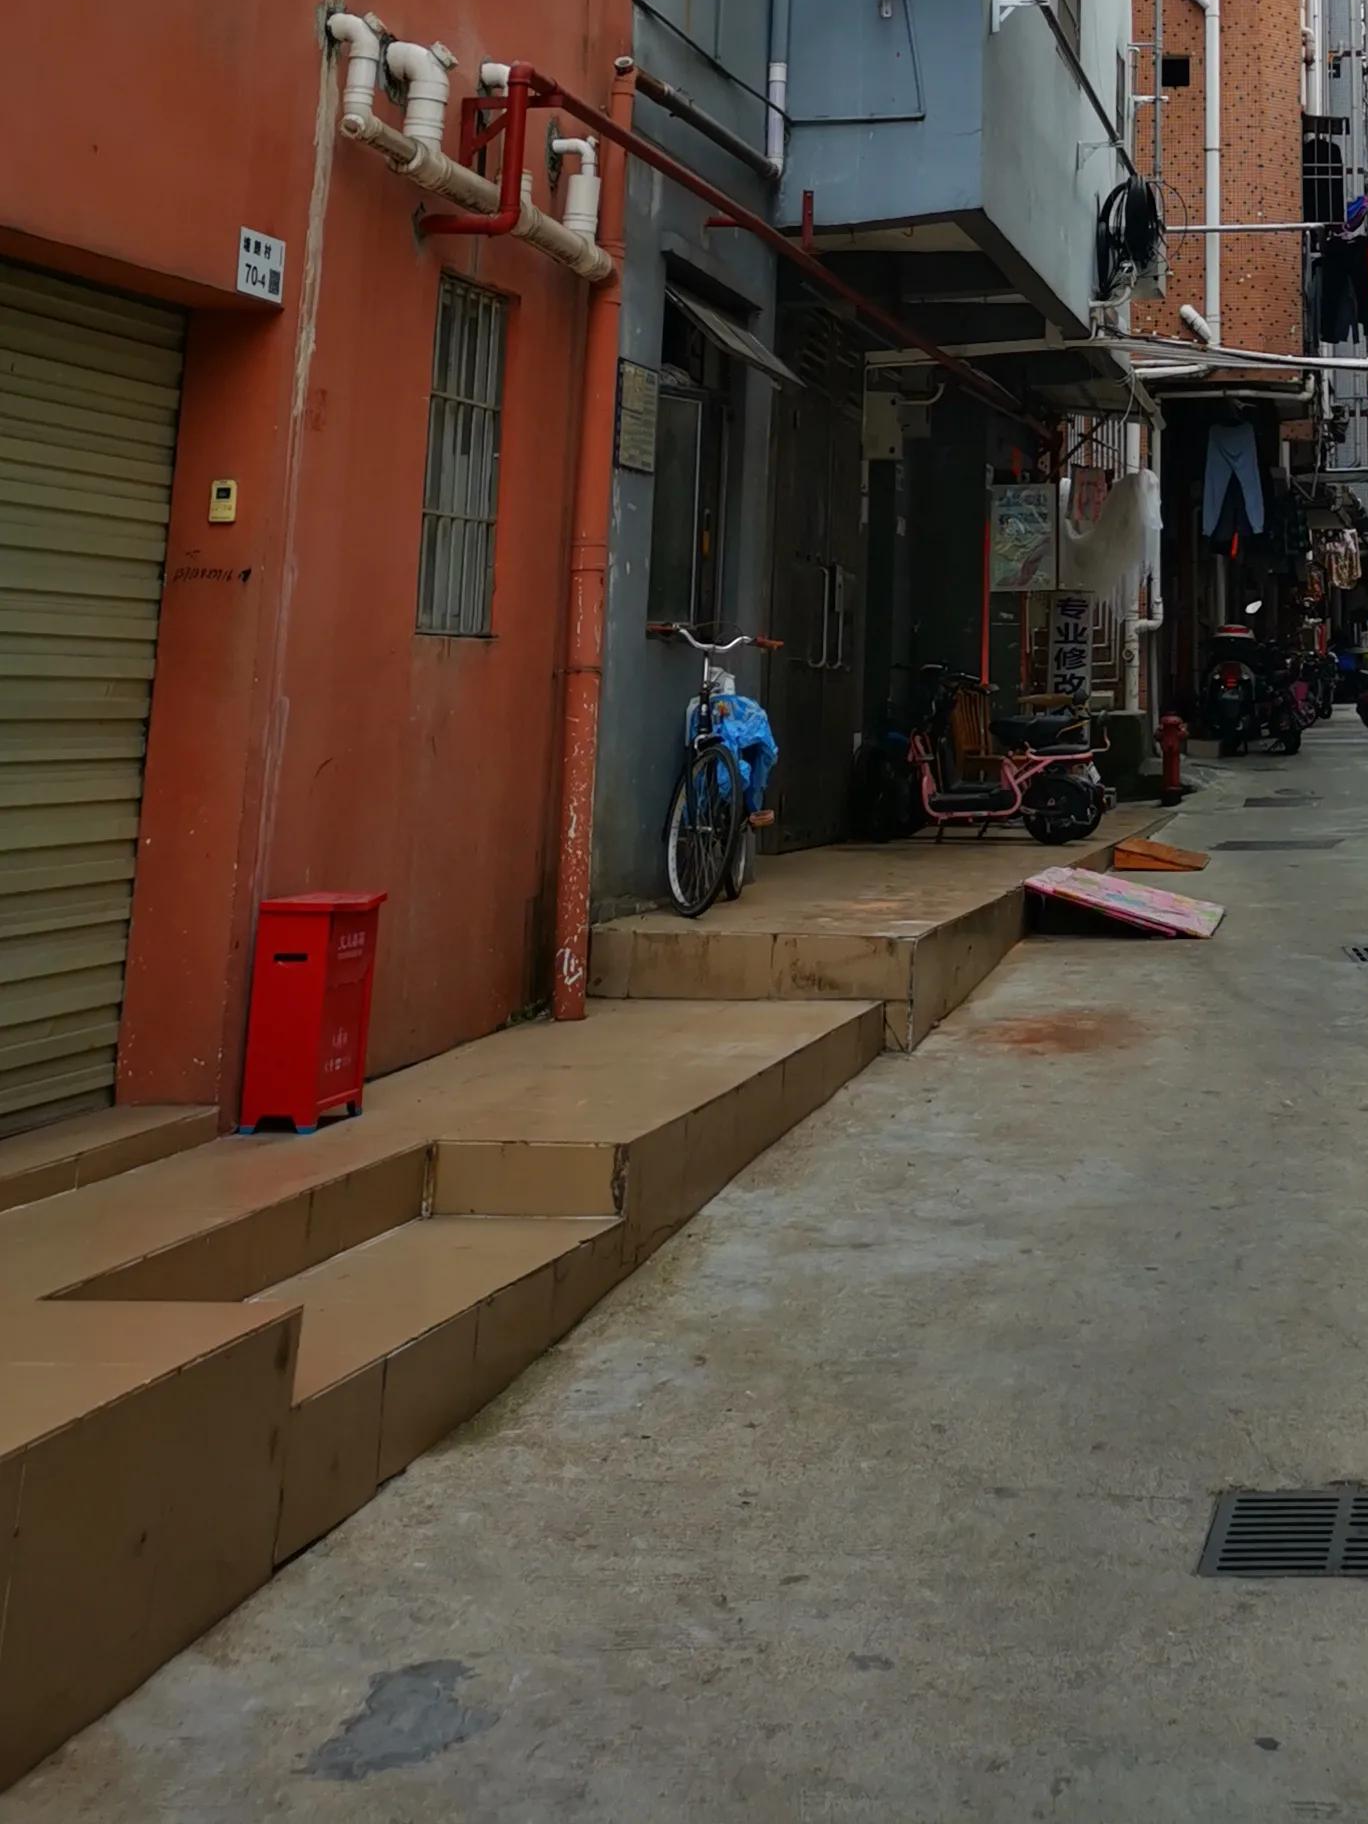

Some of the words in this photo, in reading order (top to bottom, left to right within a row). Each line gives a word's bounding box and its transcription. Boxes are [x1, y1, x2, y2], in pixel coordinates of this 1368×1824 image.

[245, 262, 267, 289] 70-4
[1053, 596, 1090, 695] 专业修改
